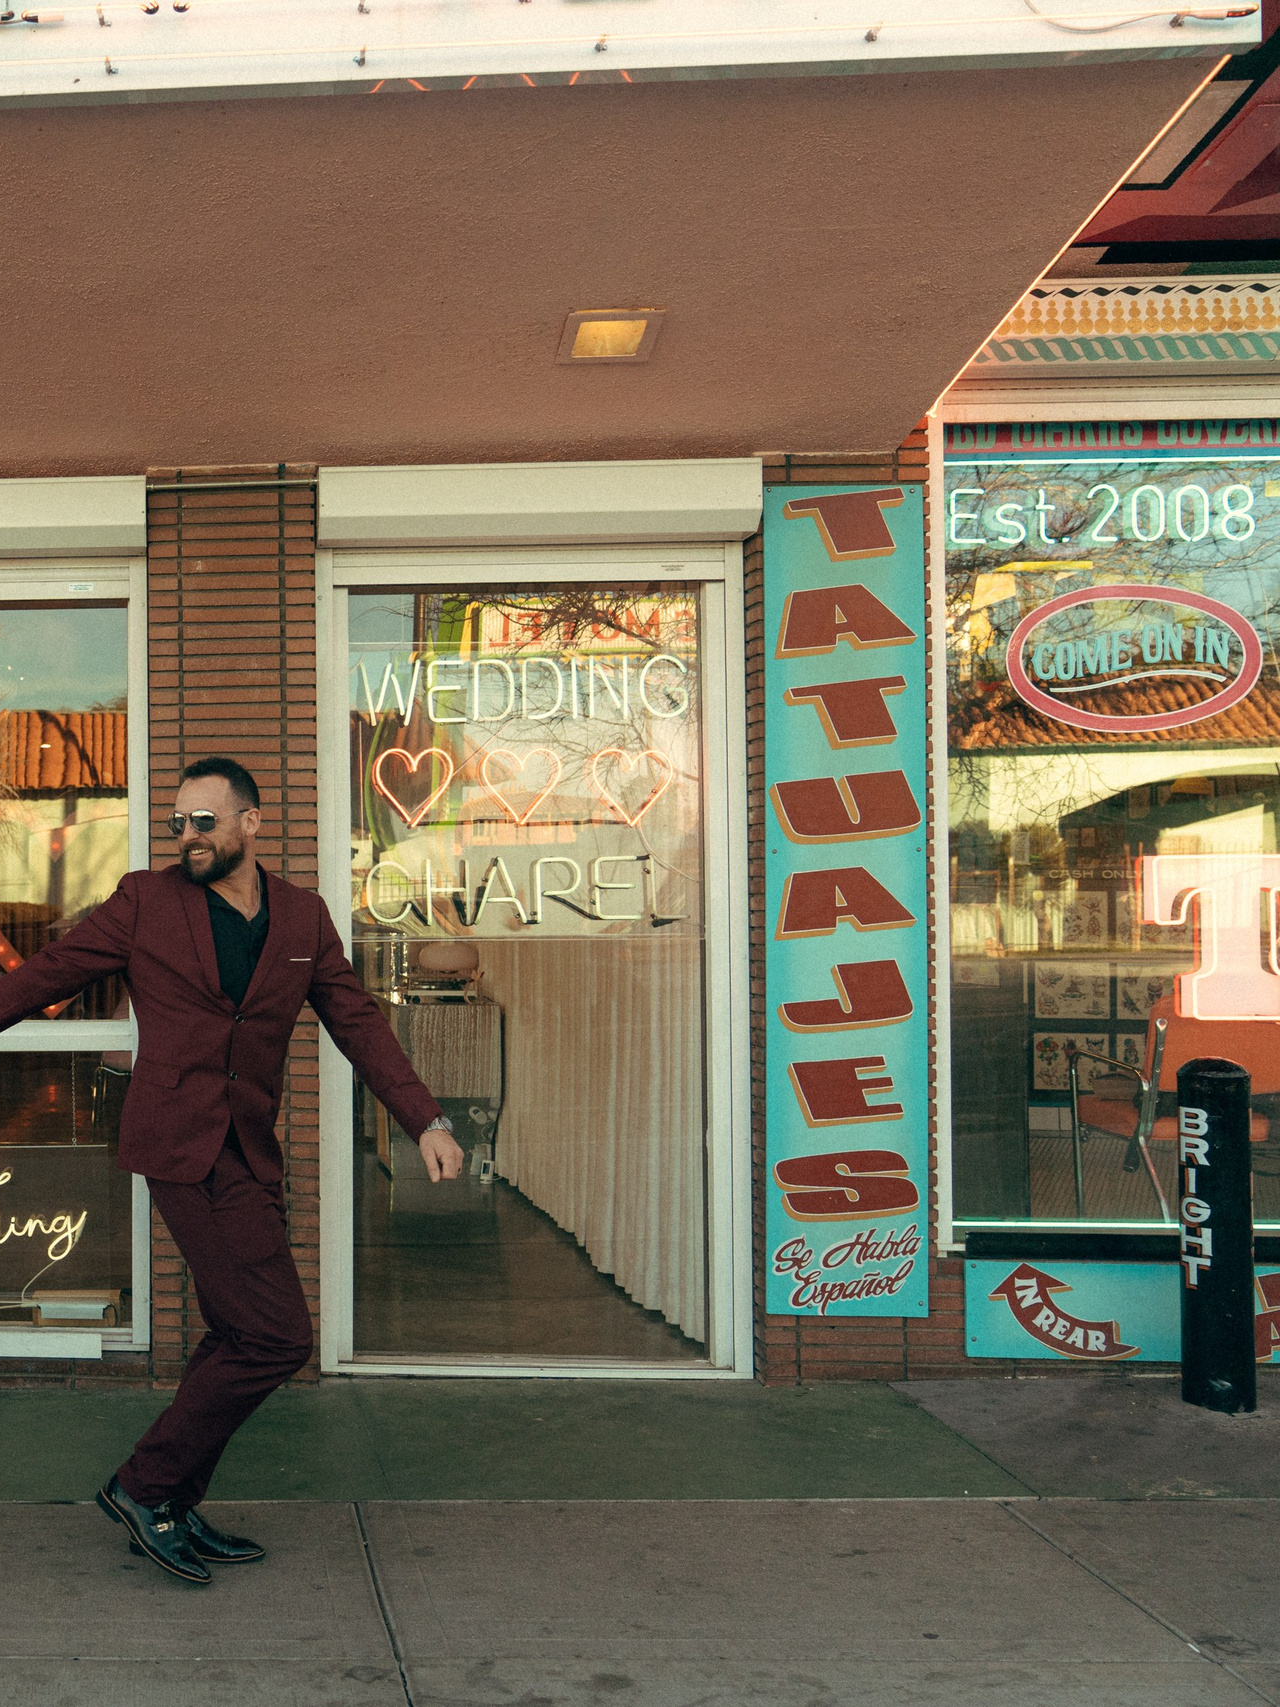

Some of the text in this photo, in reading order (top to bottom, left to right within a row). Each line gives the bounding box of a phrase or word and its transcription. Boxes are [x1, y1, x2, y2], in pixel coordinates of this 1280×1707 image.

[950, 484, 1256, 544] Est. 2008
[1031, 623, 1230, 680] COME ON IN
[360, 654, 690, 727] WEDDING
[768, 487, 922, 1222] TATUAJES
[1049, 868, 1146, 880] CASH ONLY
[365, 854, 691, 927] CHAPEL
[1179, 1106, 1214, 1291] BRIGHT
[773, 1222, 923, 1273] Se Habla
[790, 1258, 916, 1315] Español
[1014, 1276, 1108, 1352] IN REAR
